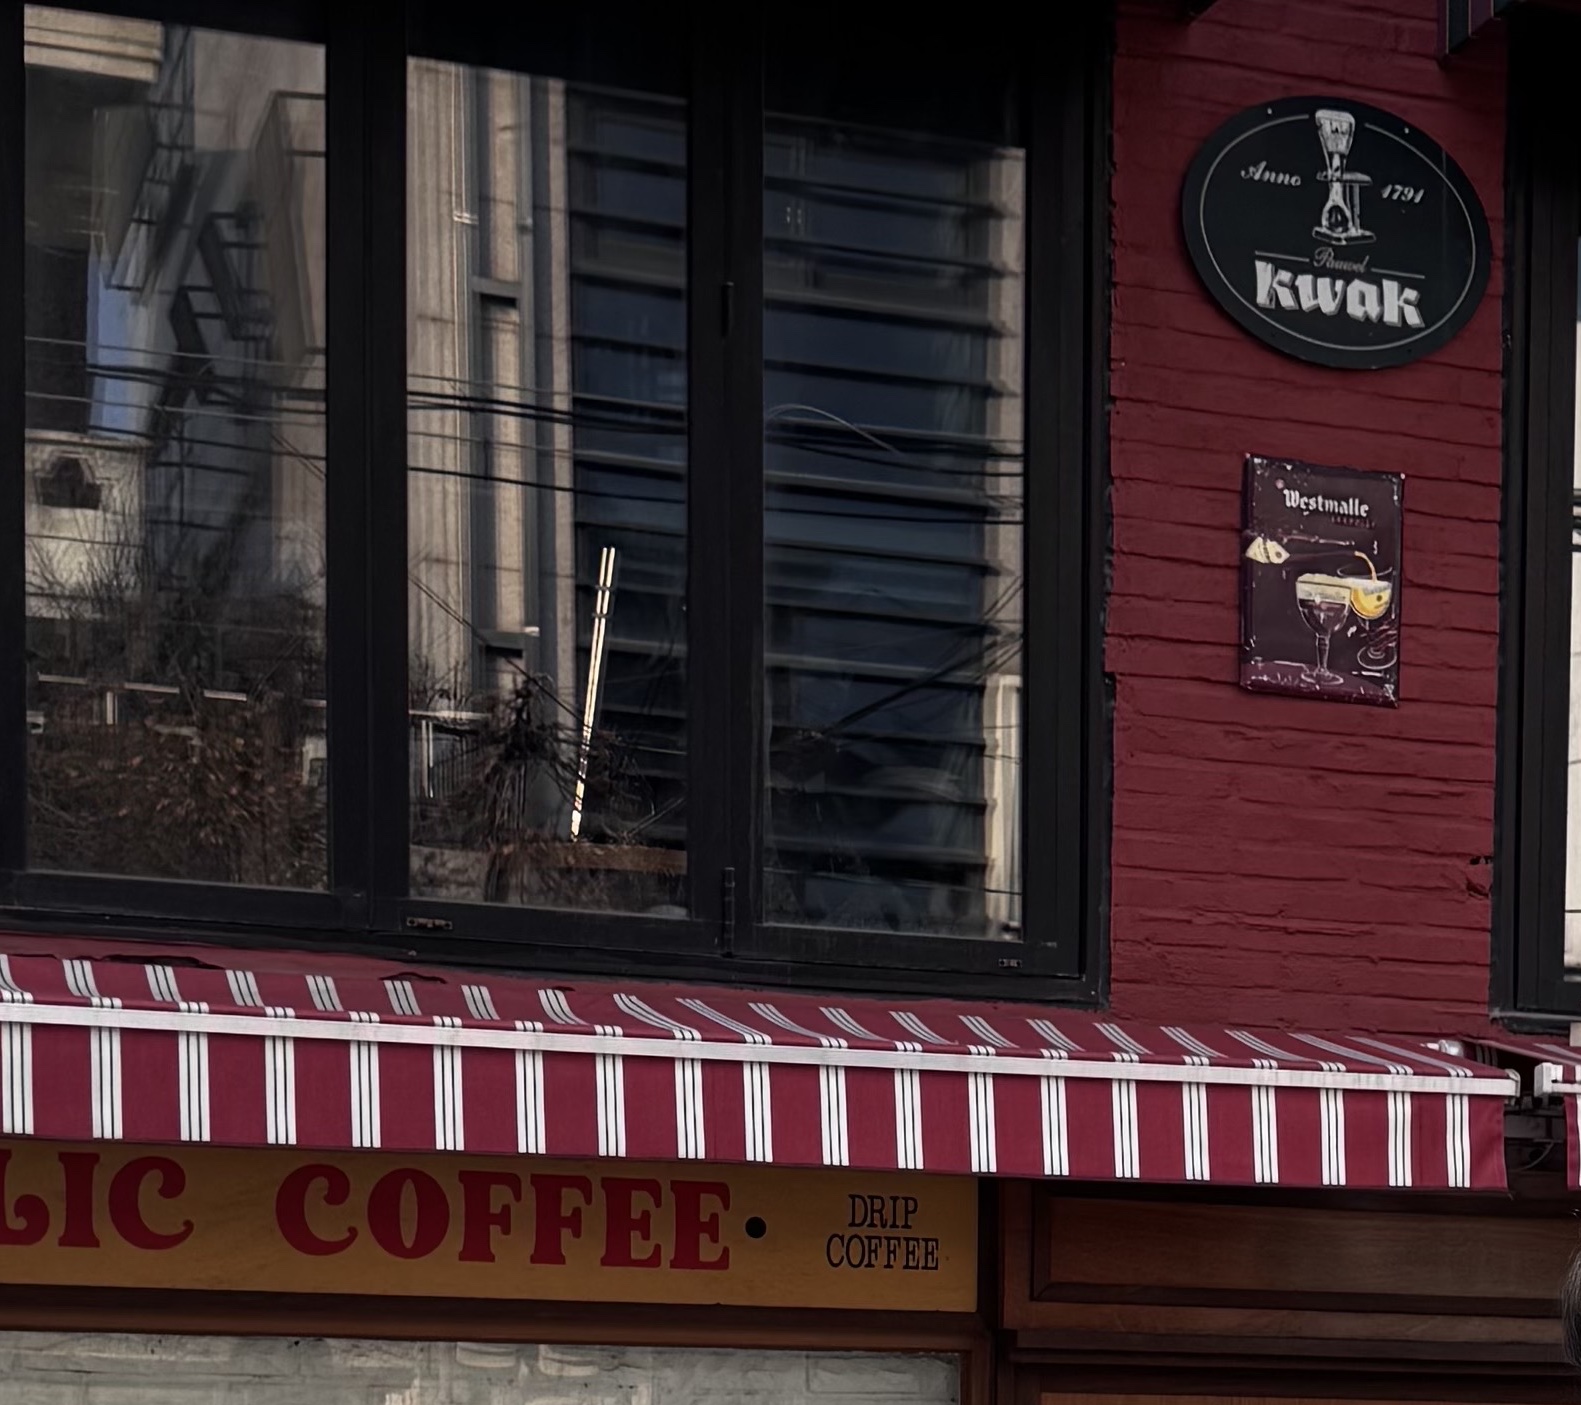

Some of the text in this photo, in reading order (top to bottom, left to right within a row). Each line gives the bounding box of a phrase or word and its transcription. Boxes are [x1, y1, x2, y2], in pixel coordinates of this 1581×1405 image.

[1240, 161, 1424, 204] Anno 1791
[1283, 488, 1370, 517] Westmalle
[275, 1163, 731, 1271] COFFEE
[848, 1193, 919, 1230] DRIP
[826, 1233, 940, 1271] COFFEE
